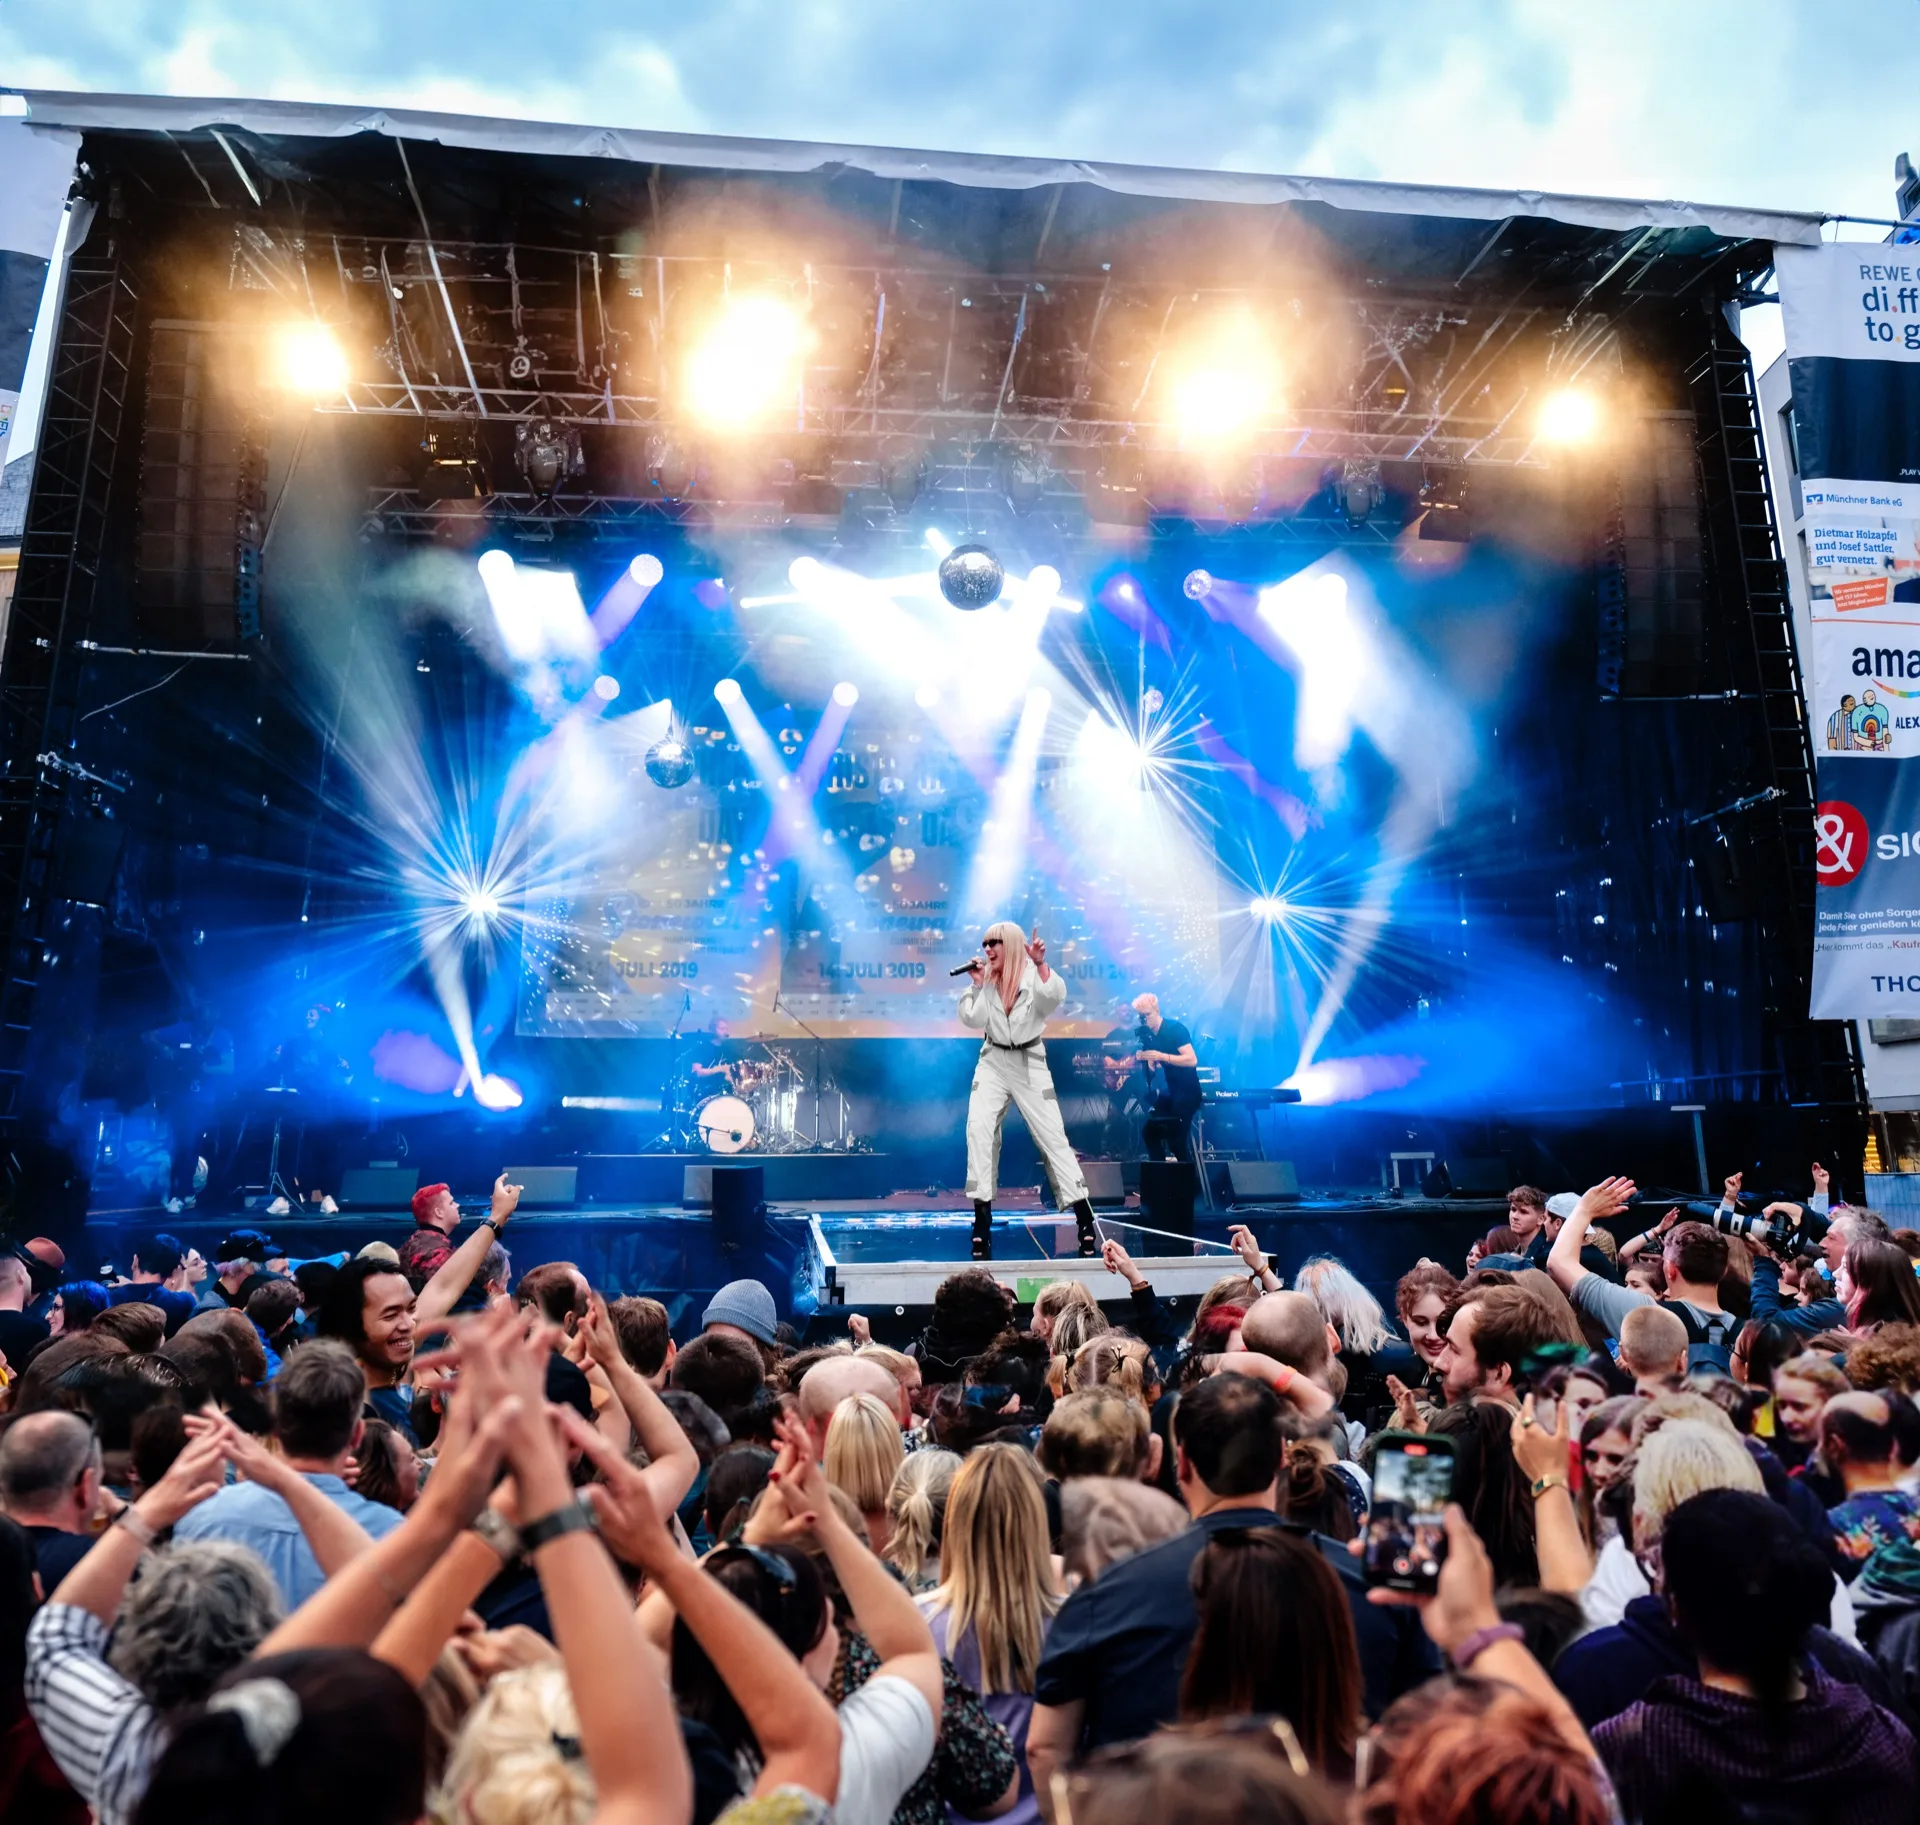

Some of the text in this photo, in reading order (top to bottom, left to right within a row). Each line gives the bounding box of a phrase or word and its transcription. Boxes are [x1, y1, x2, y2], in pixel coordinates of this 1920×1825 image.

[1860, 265, 1912, 281] REWE
[1826, 493, 1903, 507] Münchner Bank eG
[1814, 529, 1897, 542] Dietmar Holzapfel
[1815, 541, 1895, 554] und Josef Sattler,
[1816, 555, 1878, 566] gut vernetzt.
[1852, 647, 1920, 678] ama
[1819, 911, 1843, 920] Damit
[1843, 911, 1856, 920] Sie
[1858, 911, 1884, 920] ohne
[1818, 922, 1837, 933] jede
[1837, 923, 1858, 931] Feier
[1860, 920, 1908, 932] genießen
[1865, 941, 1884, 949] das
[616, 962, 653, 978] JULI
[659, 961, 699, 979] 2019
[845, 962, 882, 978] JULI
[889, 961, 926, 979] 2019
[1215, 1090, 1239, 1098] Roland
